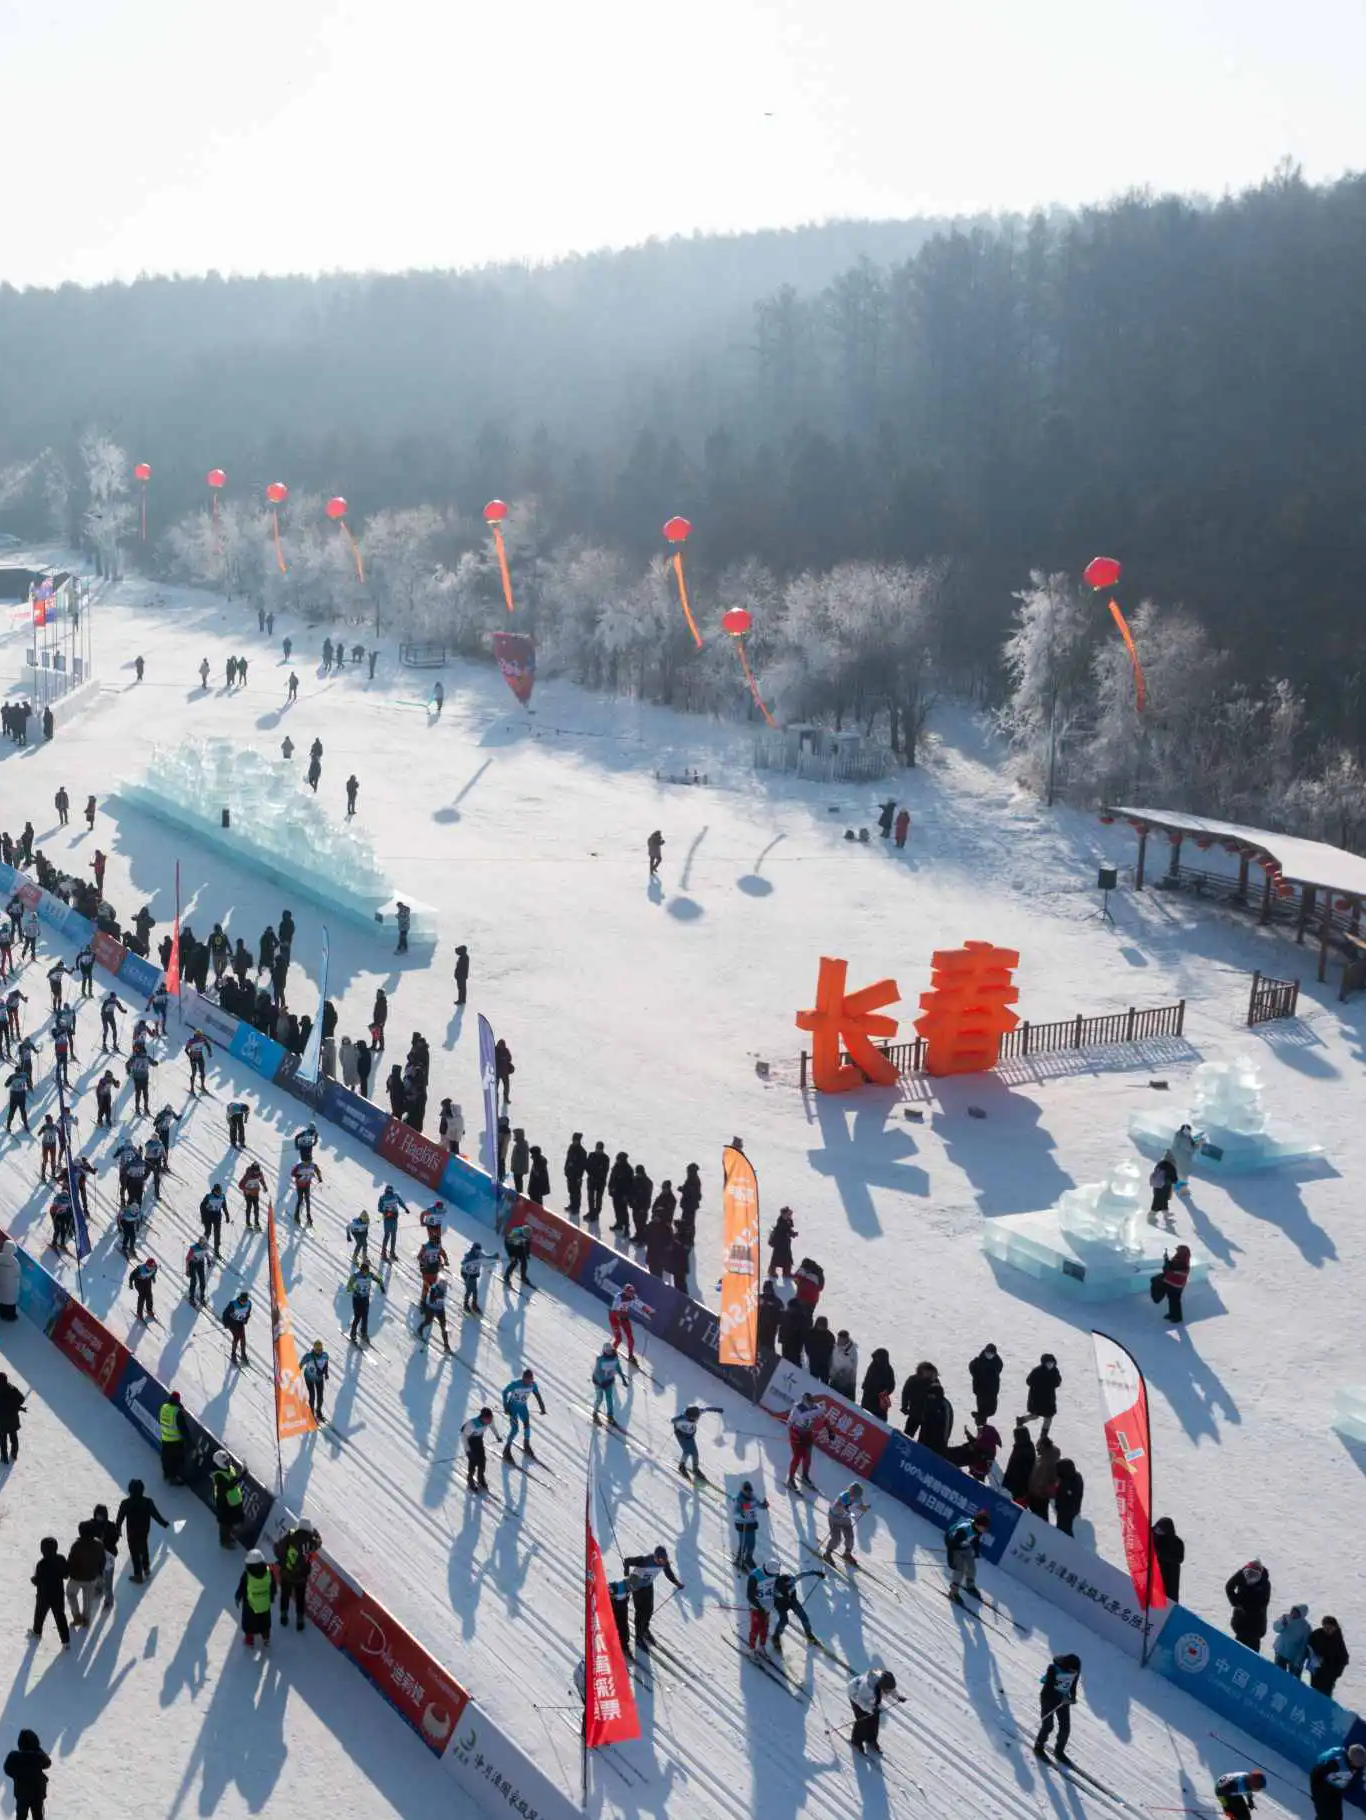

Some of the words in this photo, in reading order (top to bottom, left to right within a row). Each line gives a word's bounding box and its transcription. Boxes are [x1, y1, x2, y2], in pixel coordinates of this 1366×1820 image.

[796, 940, 1021, 1093] 长春
[1214, 1656, 1328, 1740] 中国滑雪协会
